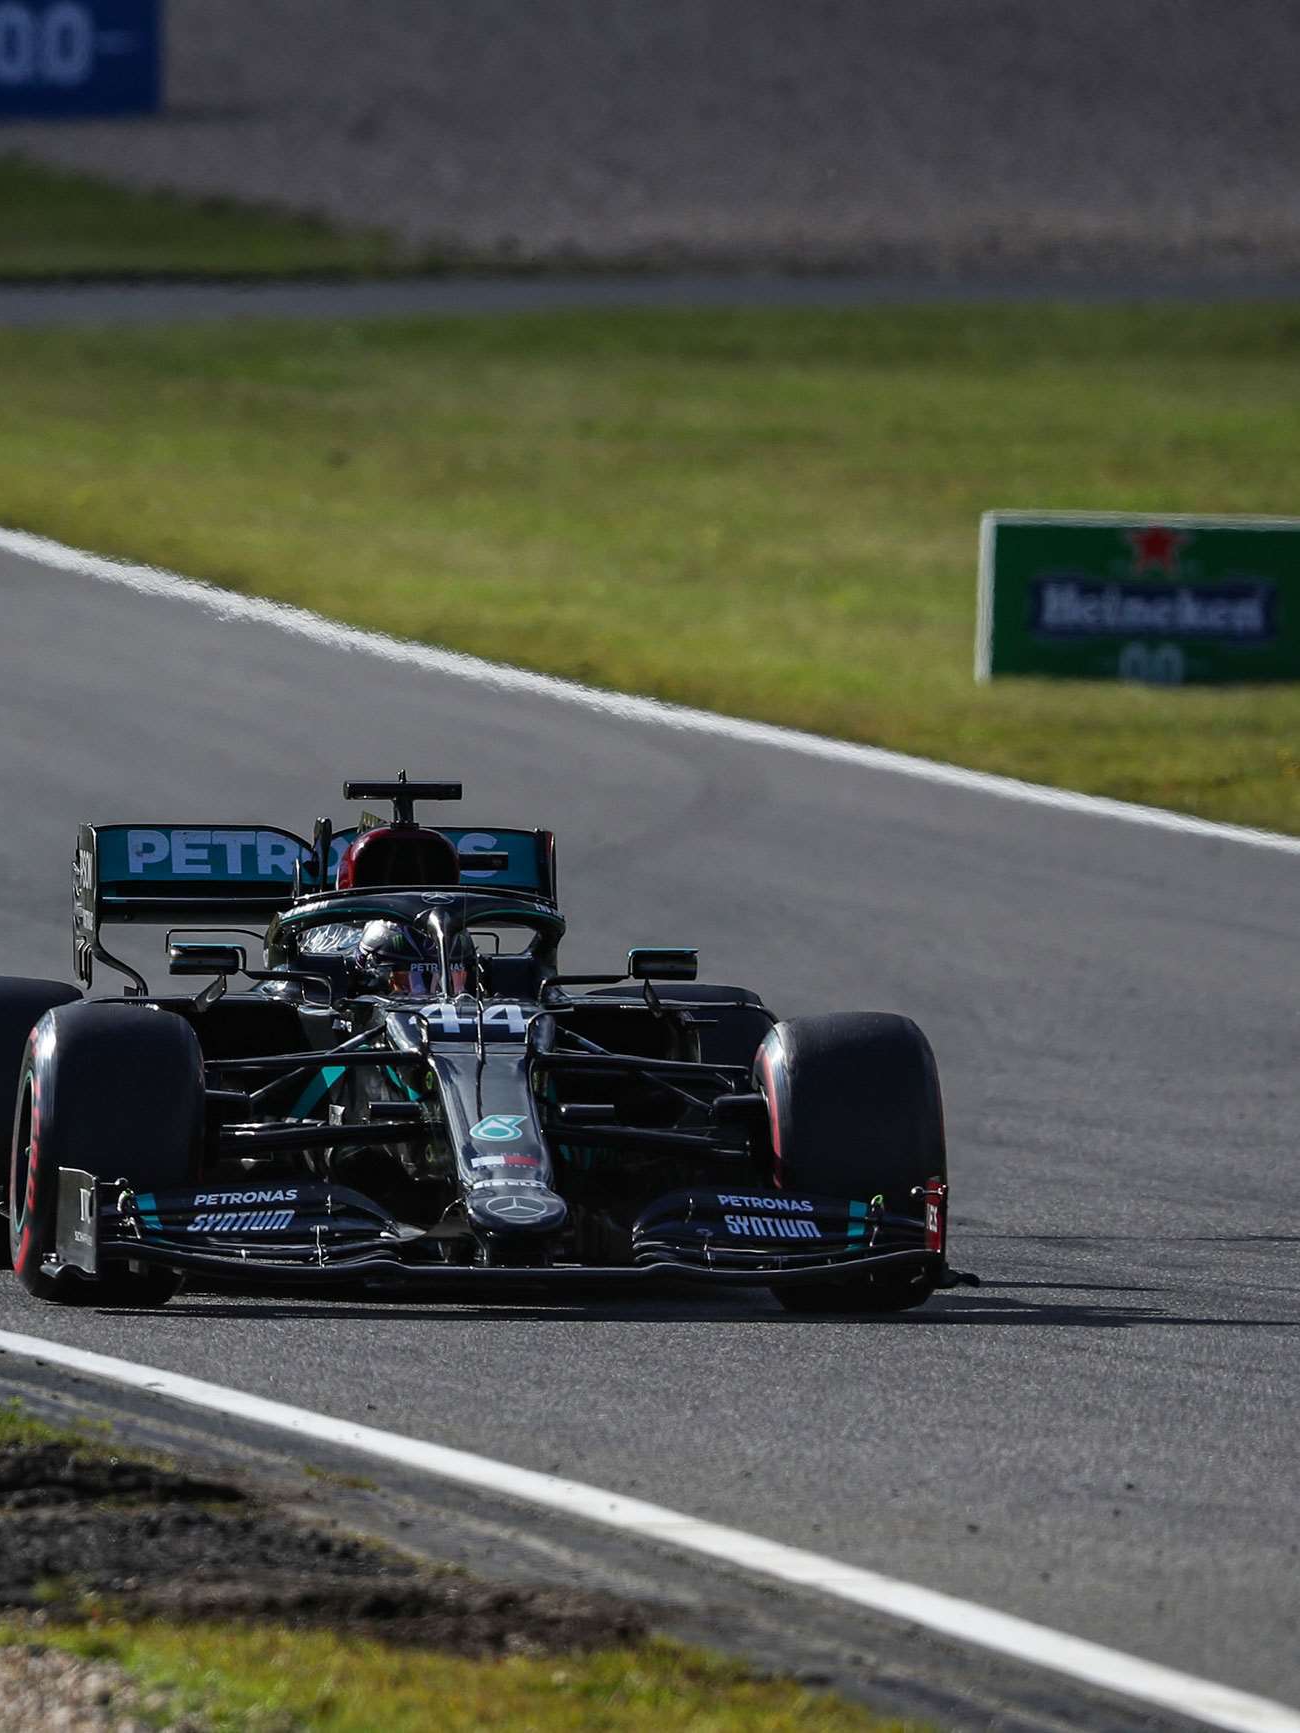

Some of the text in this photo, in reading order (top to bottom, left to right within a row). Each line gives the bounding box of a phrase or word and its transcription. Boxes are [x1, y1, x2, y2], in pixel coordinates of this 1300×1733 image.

[1042, 582, 1263, 630] Heineken
[409, 1004, 528, 1033] 44
[194, 1190, 298, 1206] PETRONAS
[717, 1195, 814, 1211] PETRONAS
